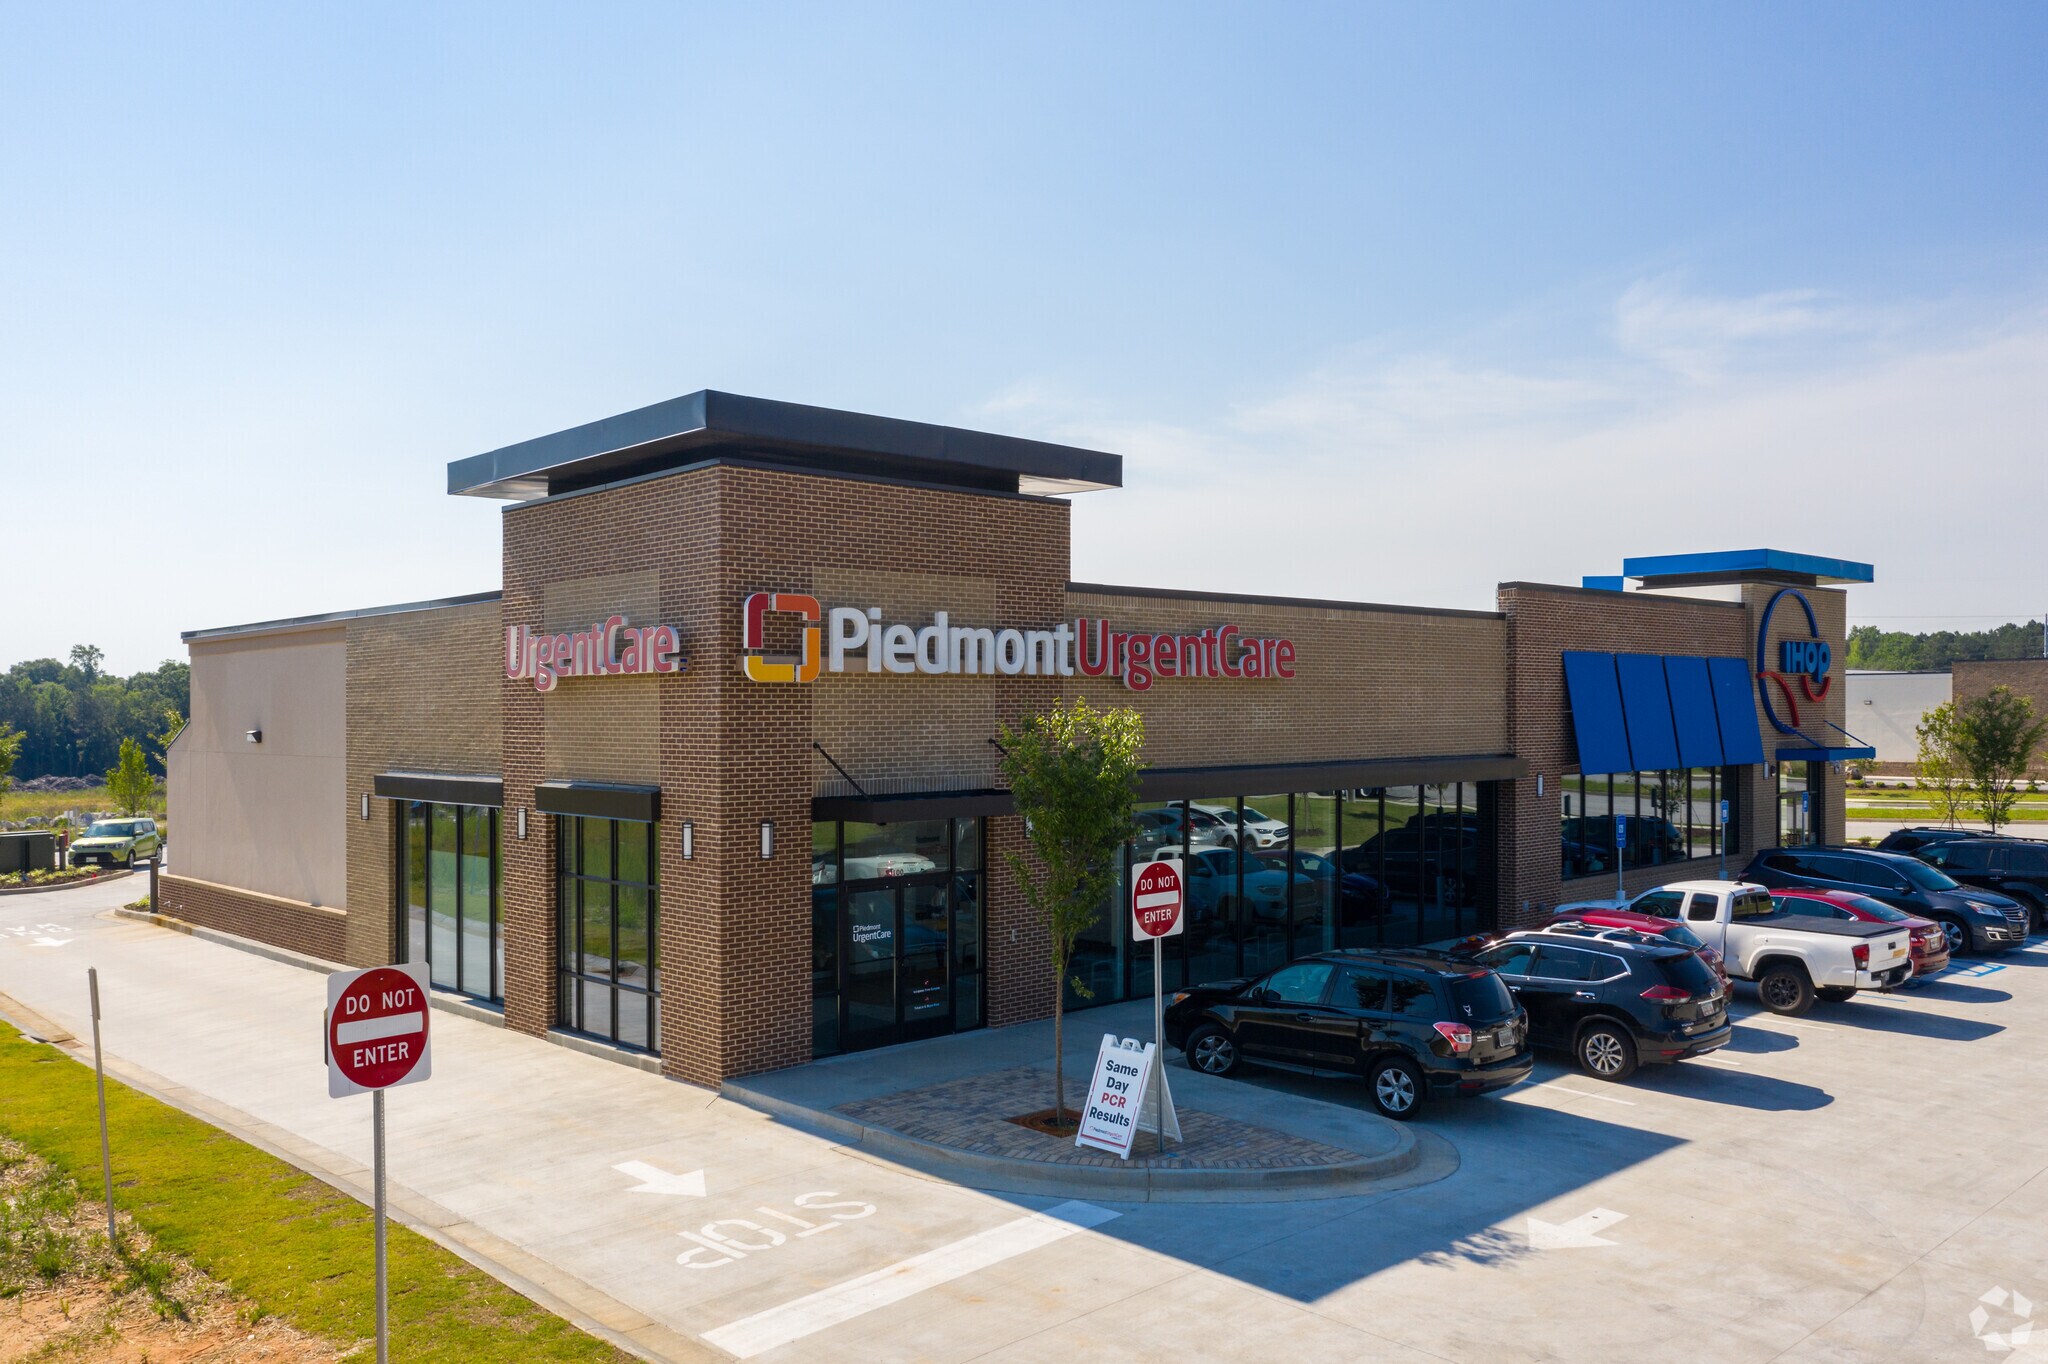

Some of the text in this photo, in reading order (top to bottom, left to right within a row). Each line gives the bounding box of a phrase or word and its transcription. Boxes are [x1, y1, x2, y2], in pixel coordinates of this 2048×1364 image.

[505, 615, 680, 691] UrgentCare
[1140, 875, 1175, 891] DO NOT
[1144, 908, 1172, 924] ENTER
[852, 930, 892, 943] UrgentCare
[346, 988, 415, 1015] DO NOT
[353, 1041, 409, 1068] ENTER
[1105, 1059, 1139, 1077] Same
[1106, 1076, 1129, 1094] Day
[1101, 1092, 1127, 1109] PCR
[1089, 1106, 1130, 1127] Results
[676, 1191, 877, 1269] STOP
